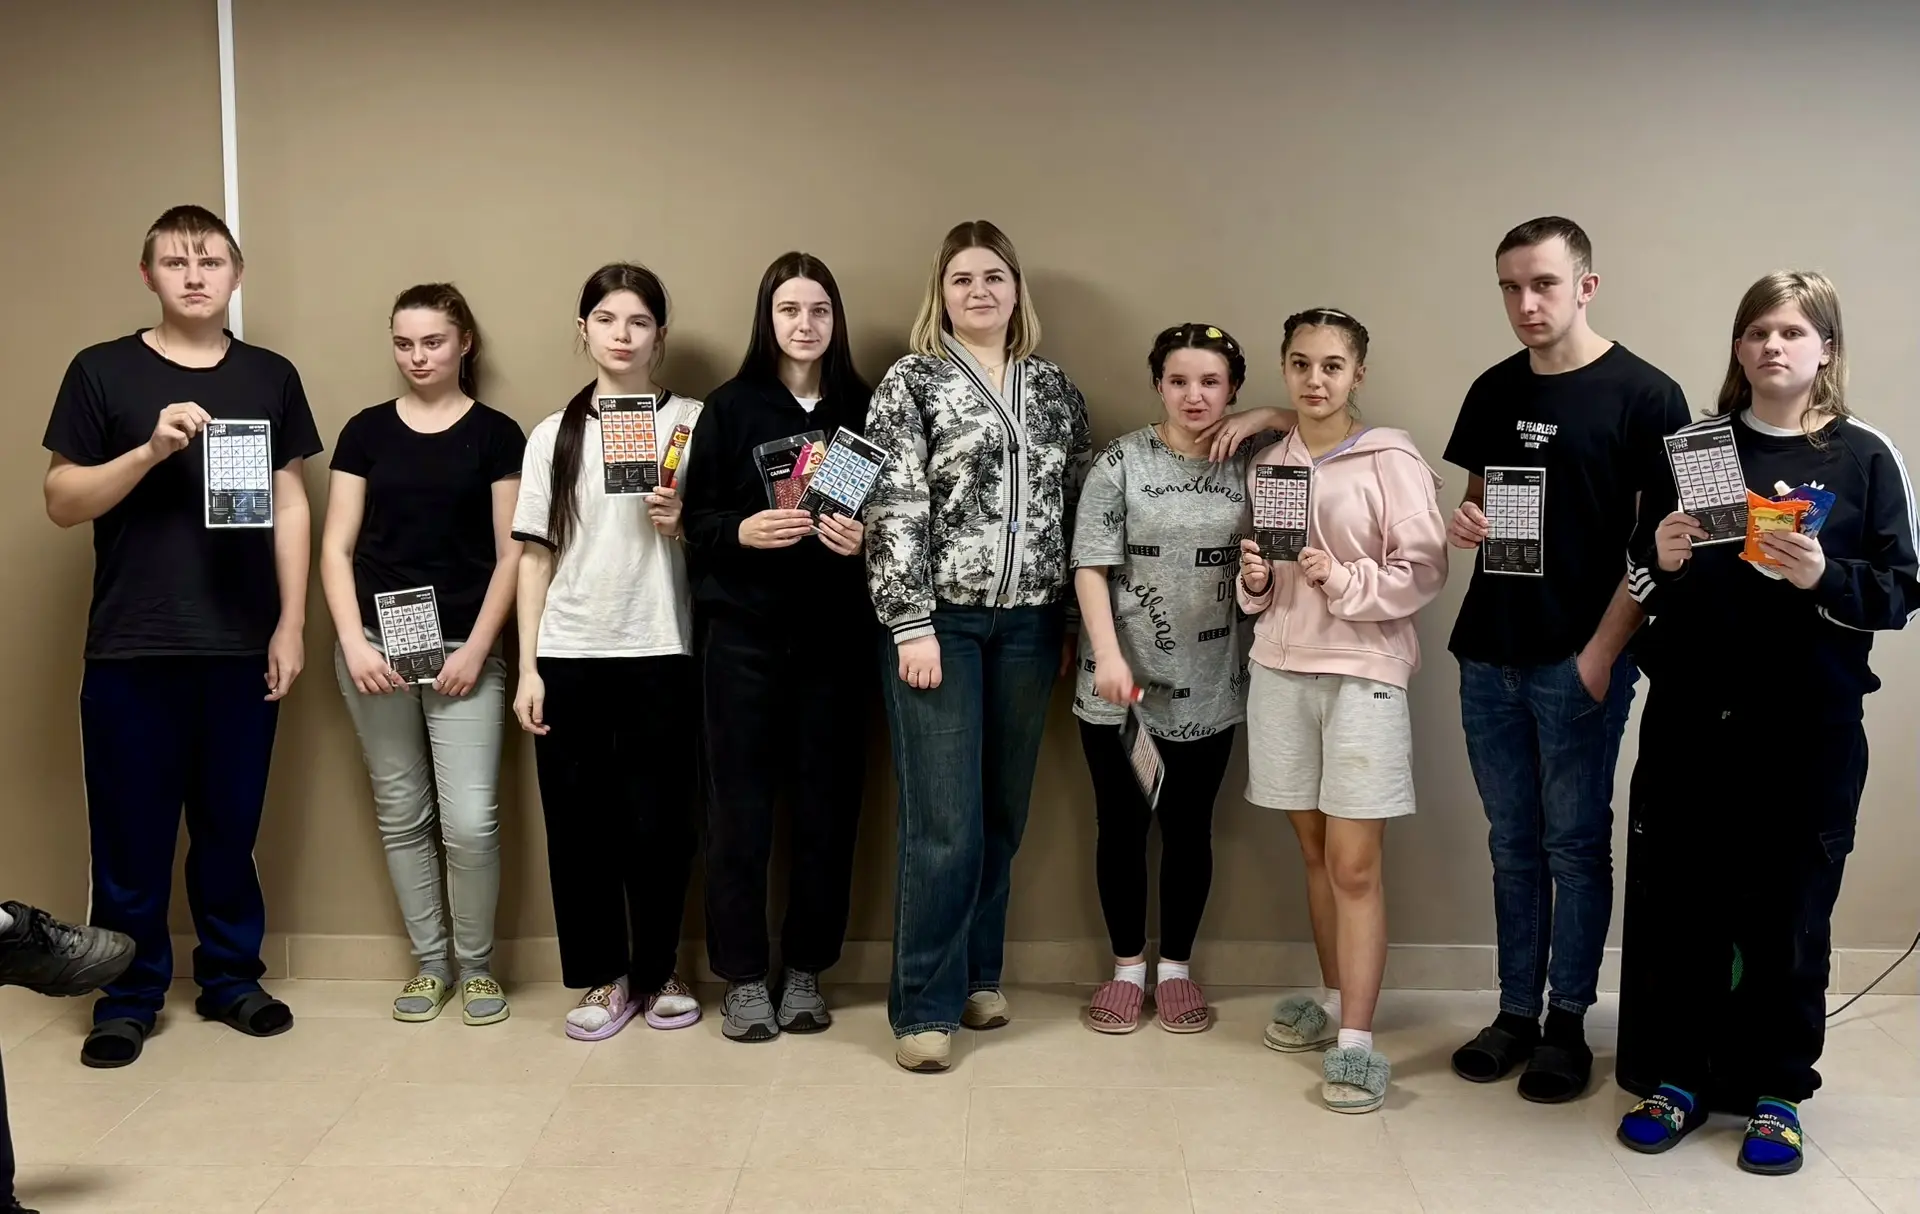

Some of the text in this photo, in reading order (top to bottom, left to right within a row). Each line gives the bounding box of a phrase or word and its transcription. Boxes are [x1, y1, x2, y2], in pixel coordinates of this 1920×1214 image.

[1516, 420, 1558, 436] BE FEARLESS
[1107, 449, 1124, 467] DO
[1758, 1113, 1777, 1121] very
